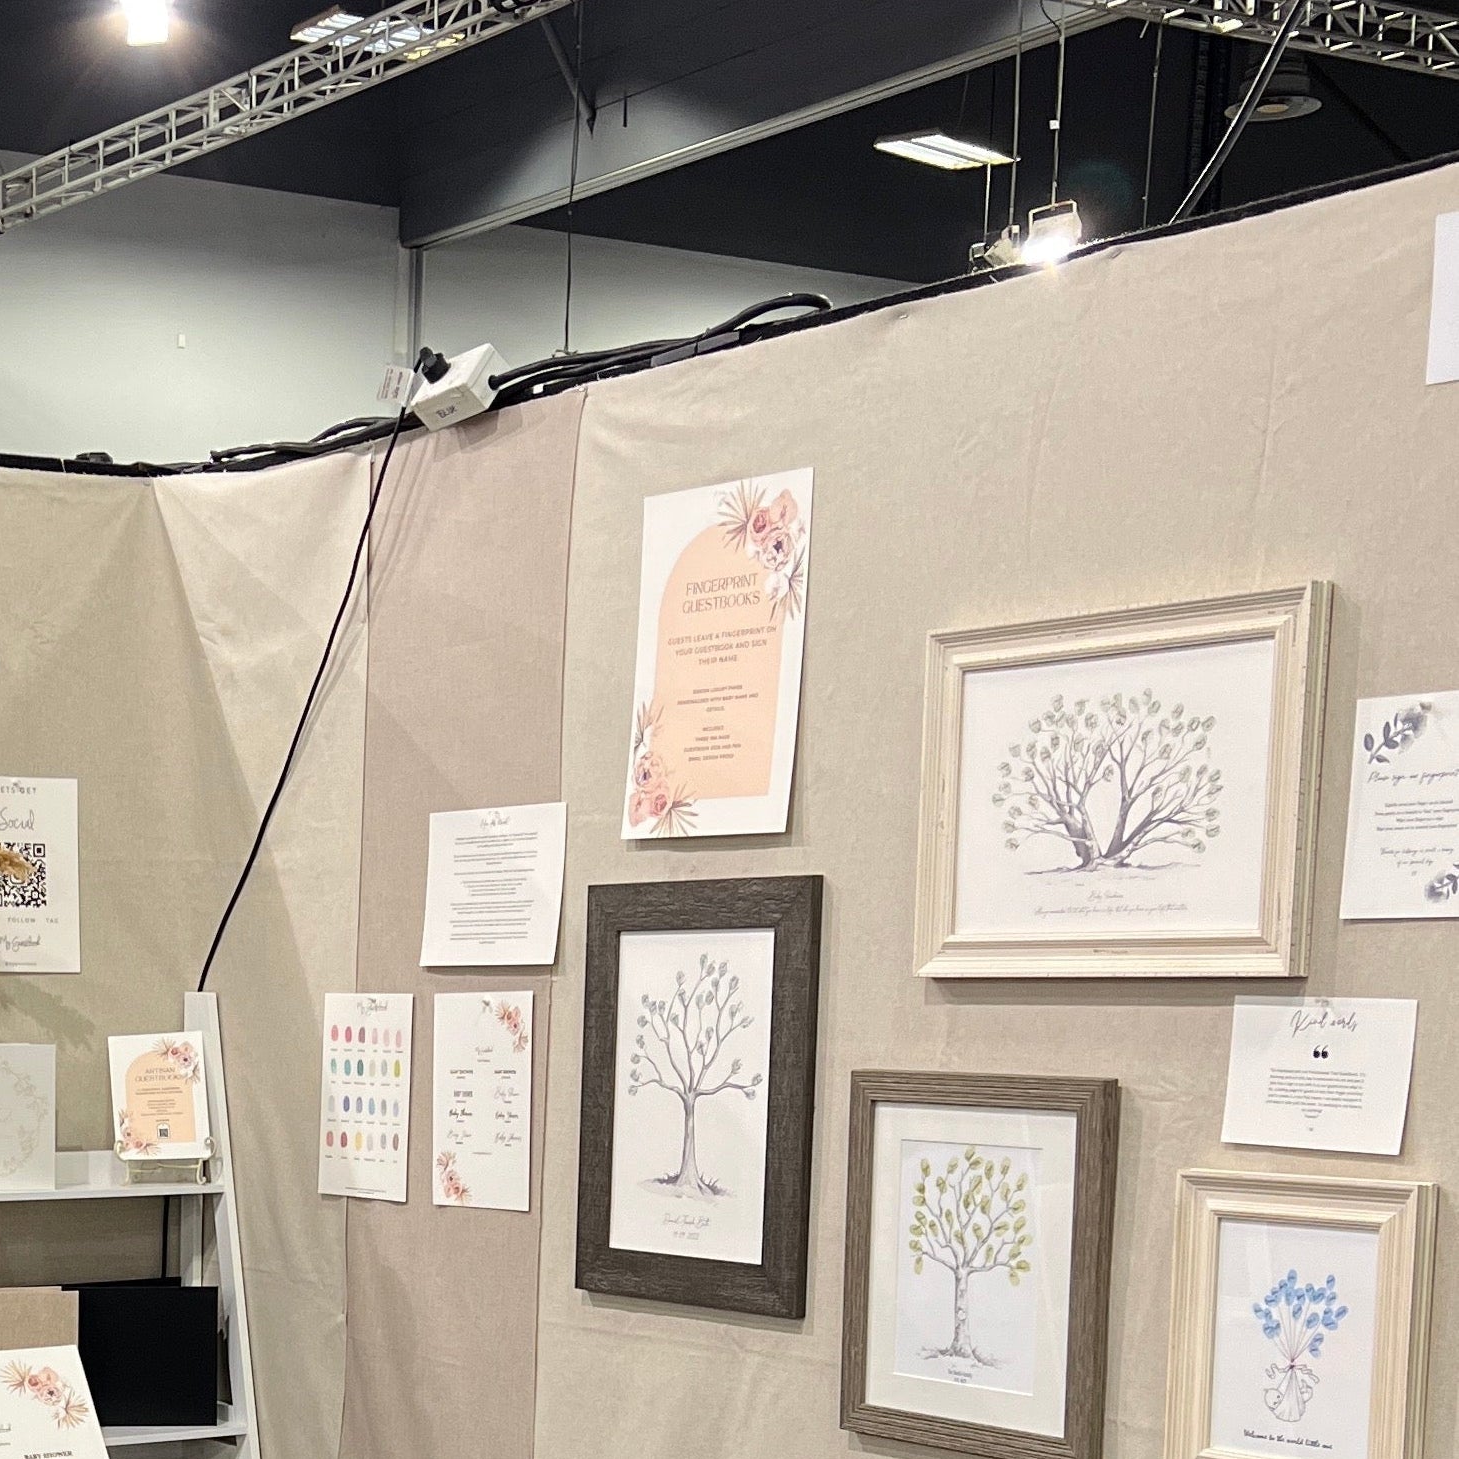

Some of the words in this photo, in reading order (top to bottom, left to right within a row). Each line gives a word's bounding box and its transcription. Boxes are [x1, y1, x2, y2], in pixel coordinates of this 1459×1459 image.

[686, 573, 758, 596] FINGERPRINT
[682, 591, 761, 614] GUESTBOOKS
[668, 636, 692, 646] GUESTS
[693, 633, 714, 643] LEAVE
[721, 627, 766, 638] FINGERPRINT
[675, 647, 693, 657] YOUR
[694, 643, 734, 655] GUESTBOOK
[735, 640, 750, 649] AND
[752, 639, 767, 648] SIGN
[698, 656, 718, 665] THEIR
[719, 655, 738, 663] NAME
[1291, 1009, 1329, 1038] Kind
[1244, 1429, 1267, 1440] Welcome
